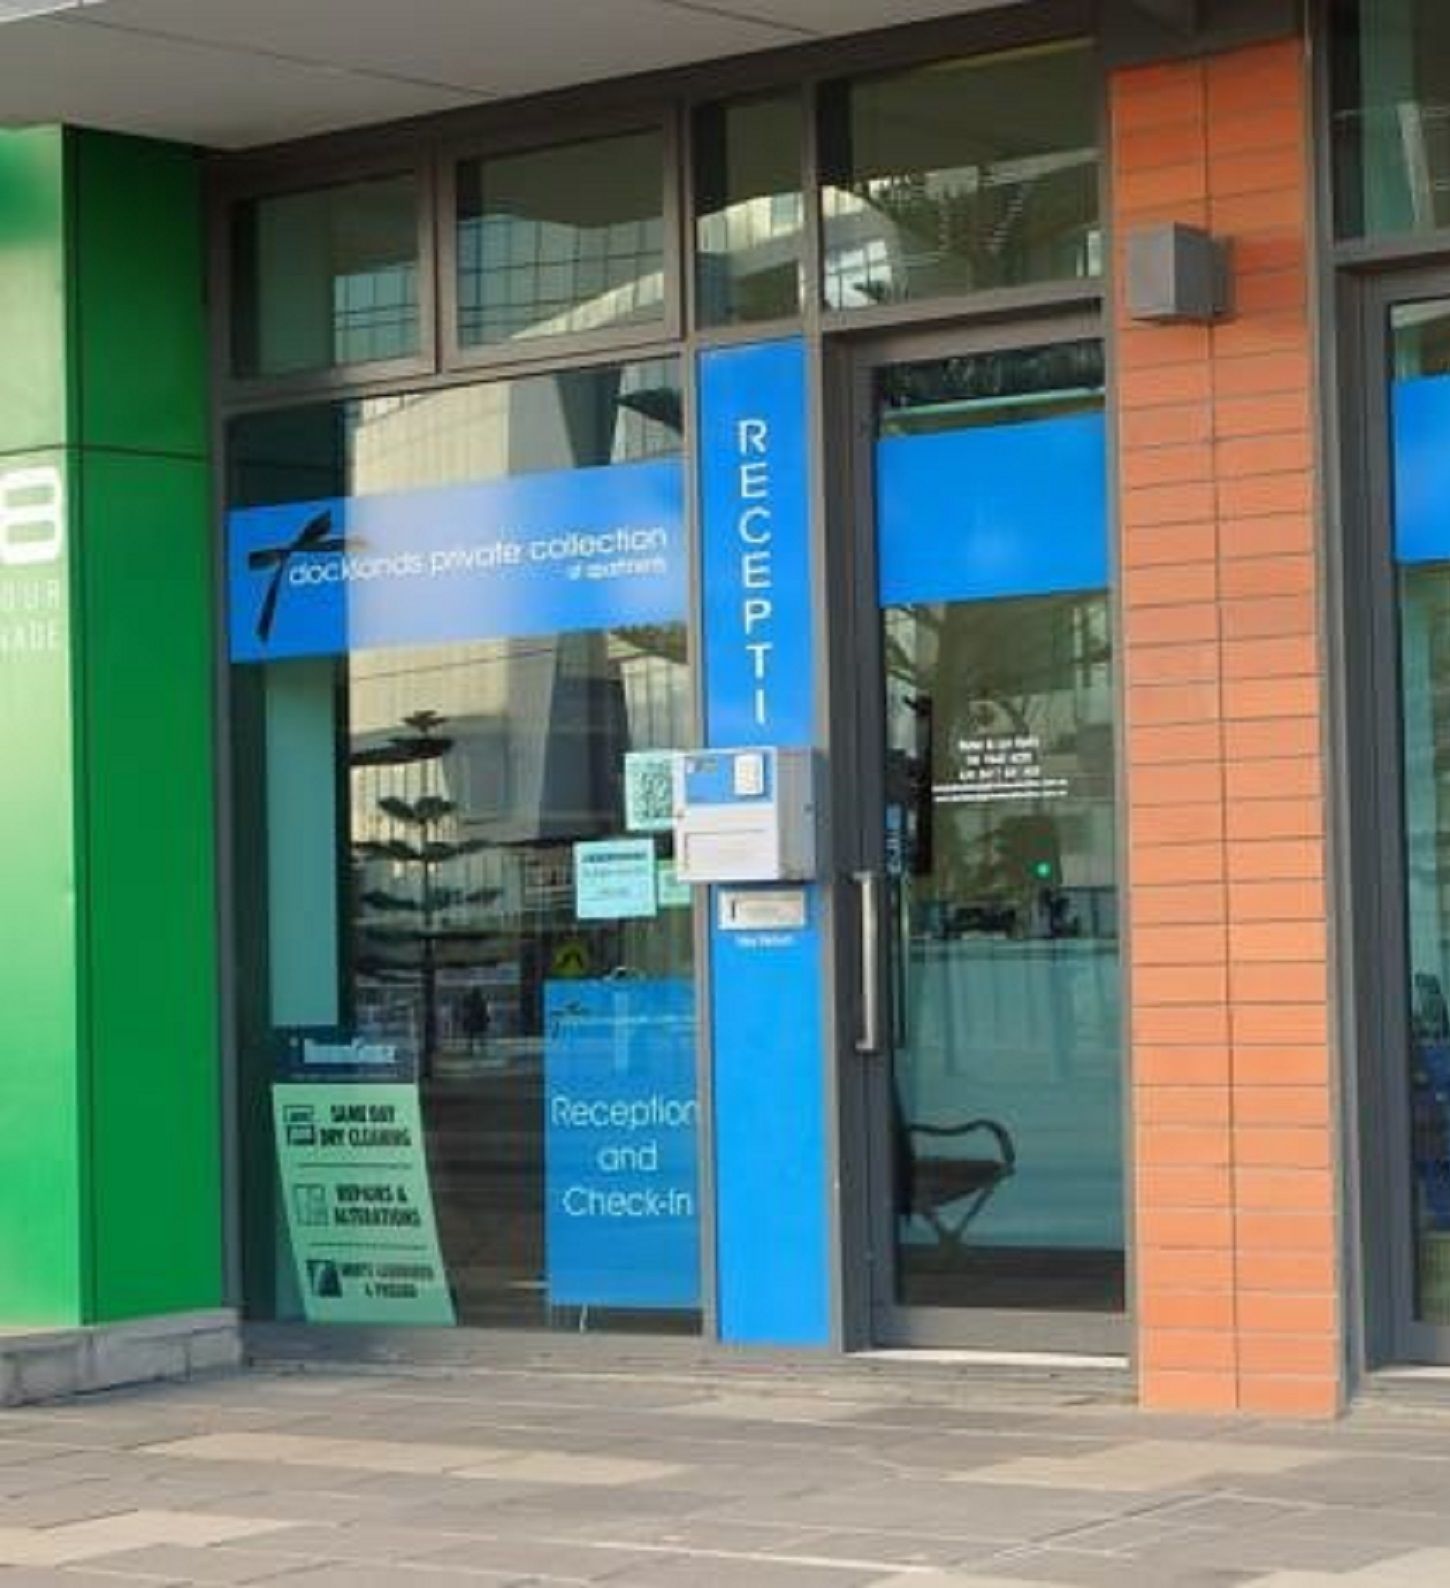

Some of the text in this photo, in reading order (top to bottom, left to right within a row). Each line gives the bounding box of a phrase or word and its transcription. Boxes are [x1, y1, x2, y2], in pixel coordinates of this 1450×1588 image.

[289, 525, 666, 585] docklands private collection
[552, 1093, 699, 1130] Reception
[597, 1140, 658, 1171] and
[562, 1186, 693, 1216] Check-In
